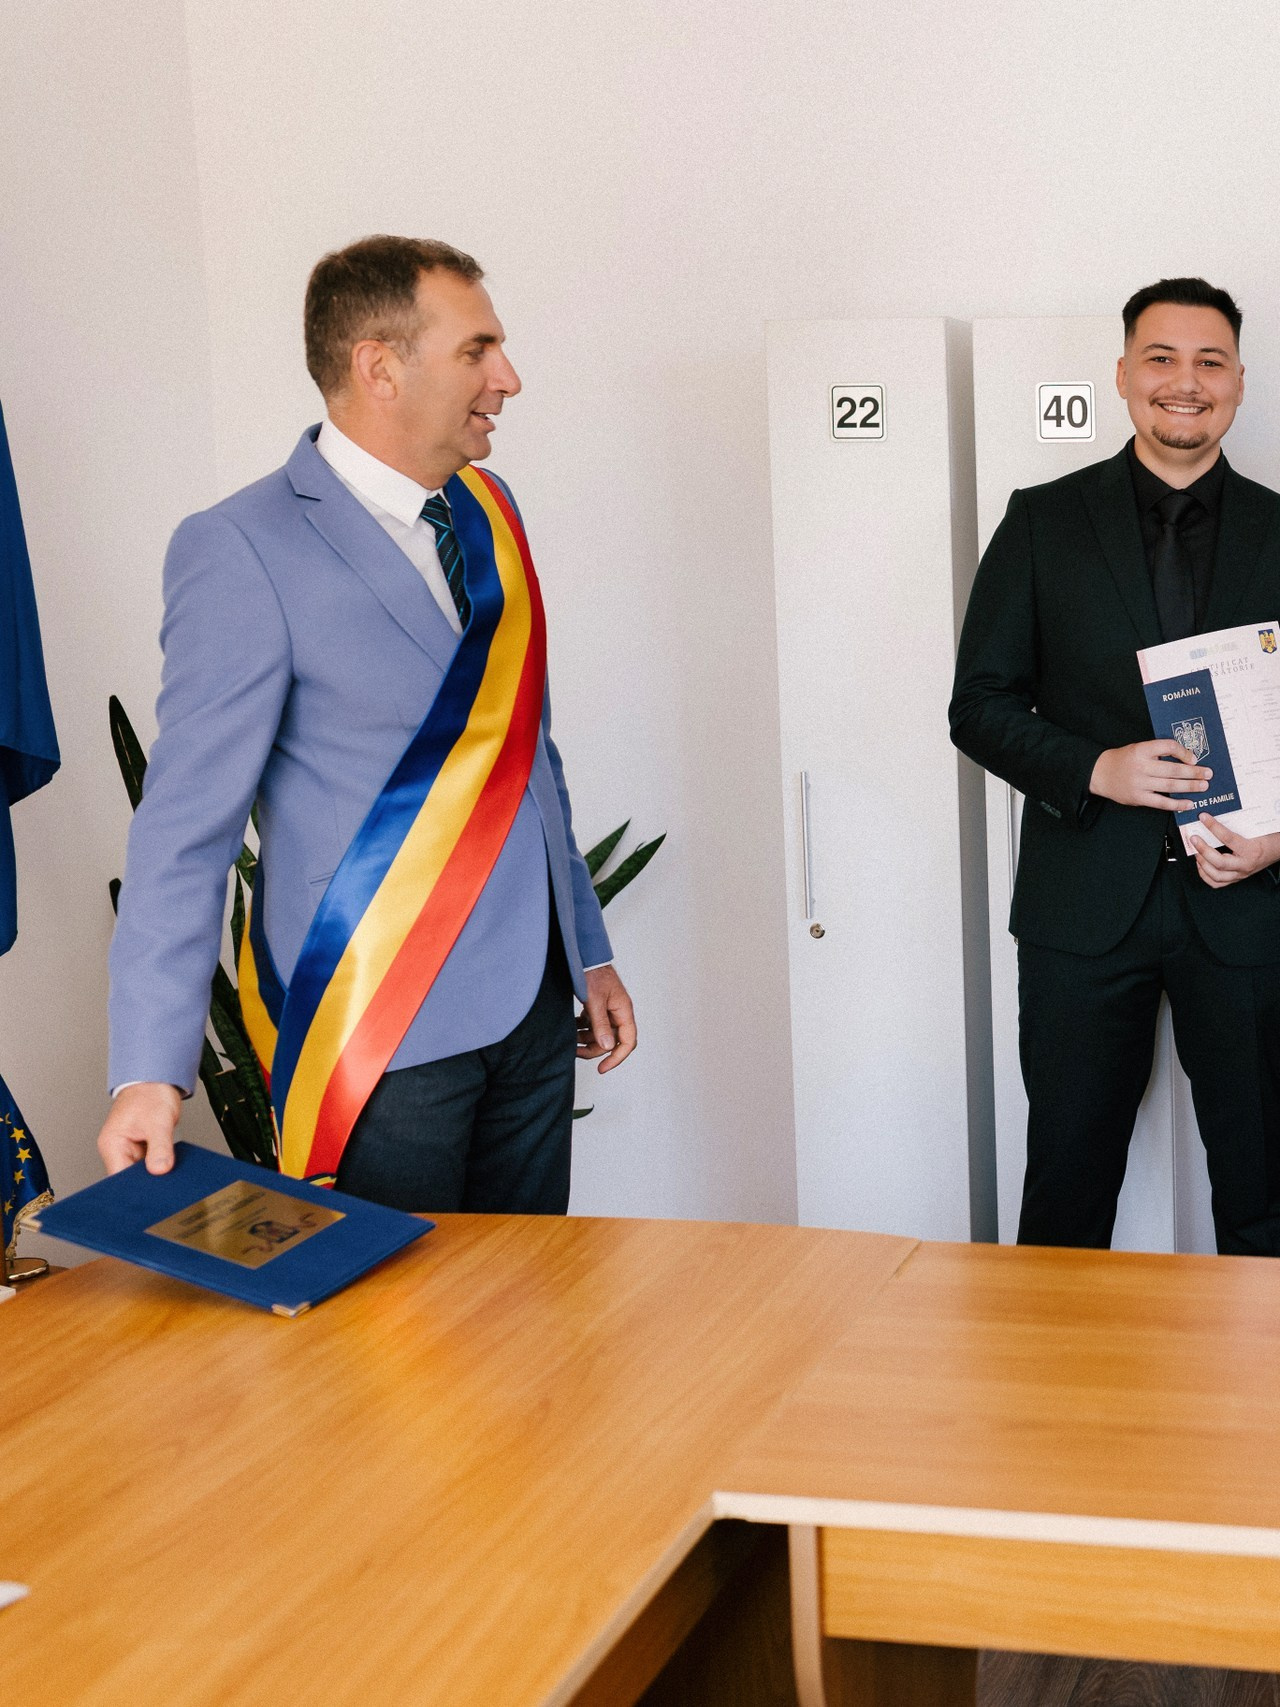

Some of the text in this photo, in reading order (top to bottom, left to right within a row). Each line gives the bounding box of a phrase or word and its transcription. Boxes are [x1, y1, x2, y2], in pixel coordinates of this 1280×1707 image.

[836, 396, 880, 429] 22
[1043, 395, 1088, 428] 40
[1162, 687, 1201, 702] ROMÂNIA
[1198, 799, 1208, 808] DE
[1208, 792, 1235, 805] FAMILIE
